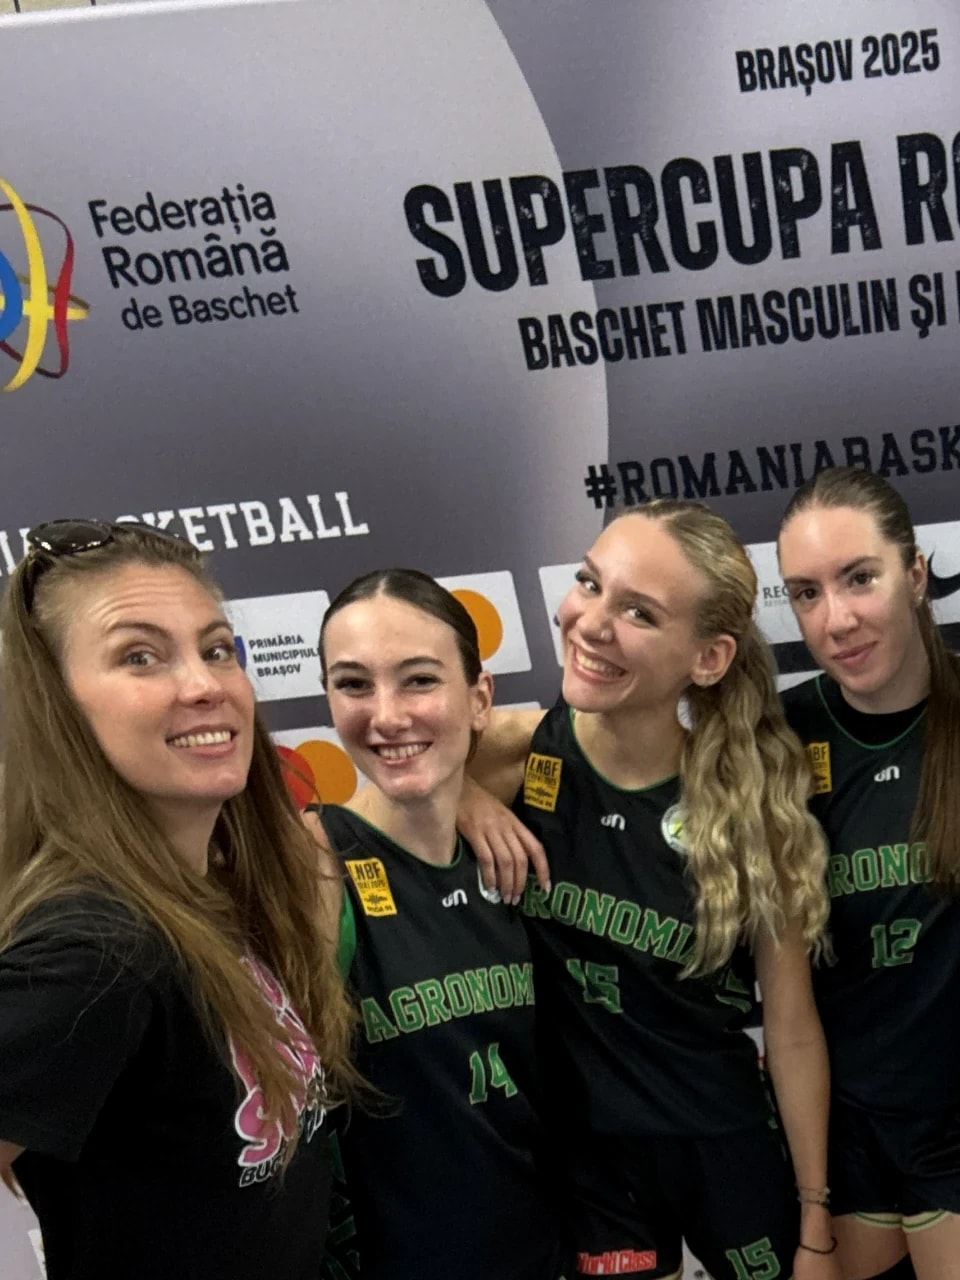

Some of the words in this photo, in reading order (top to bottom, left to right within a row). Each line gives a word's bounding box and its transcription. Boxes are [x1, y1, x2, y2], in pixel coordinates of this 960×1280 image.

[862, 28, 941, 78] 2025
[403, 140, 882, 298] SUPERCUPA
[102, 227, 289, 289] Română
[120, 302, 164, 331] de
[171, 284, 301, 327] Baschet
[517, 300, 688, 371] BASCHET
[699, 278, 900, 352] MASCULIN
[253, 648, 320, 663] MUNICIPIUL
[870, 918, 923, 969] 12
[360, 963, 535, 1043] AGRONOM
[469, 1043, 518, 1105] 14
